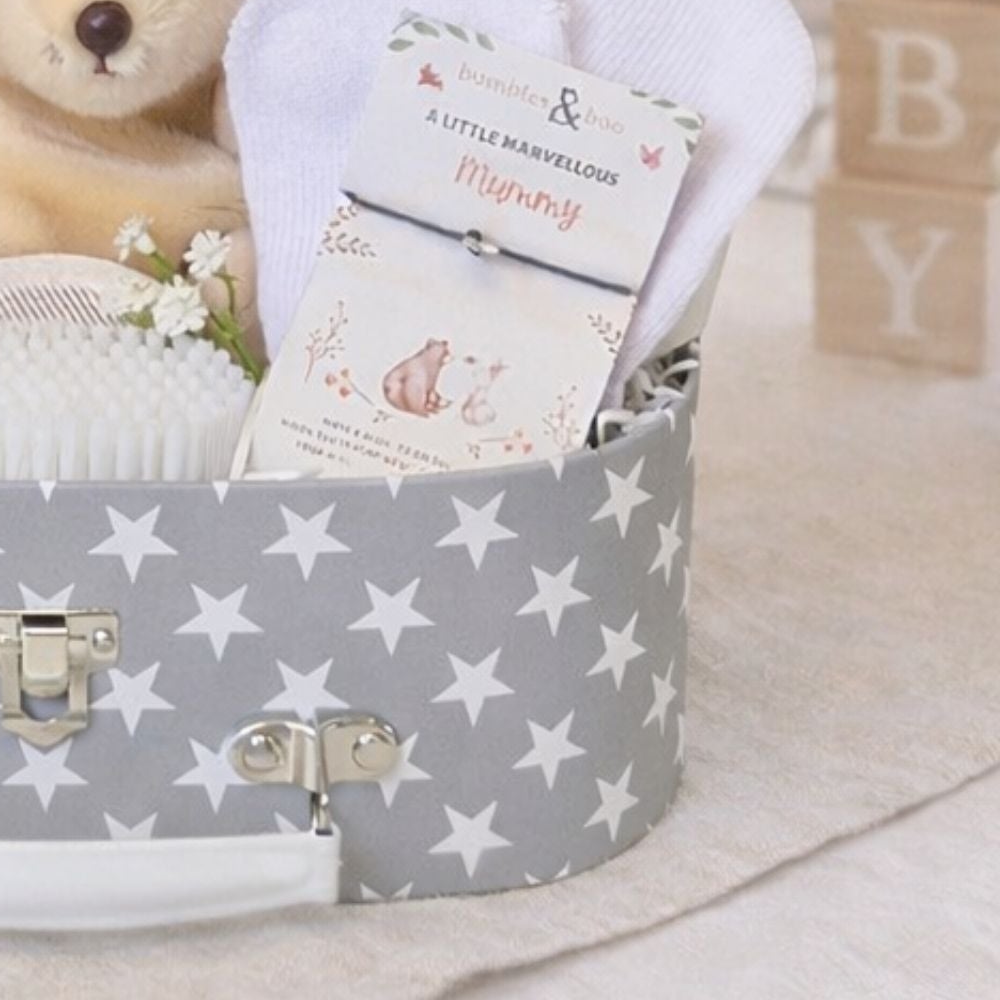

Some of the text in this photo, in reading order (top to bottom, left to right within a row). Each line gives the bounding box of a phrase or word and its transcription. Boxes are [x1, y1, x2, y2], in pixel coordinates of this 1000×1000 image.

[457, 61, 626, 135] bumbles & boo
[425, 108, 621, 187] A LITTLE MARVELLOUS
[453, 153, 583, 233] Mummy
